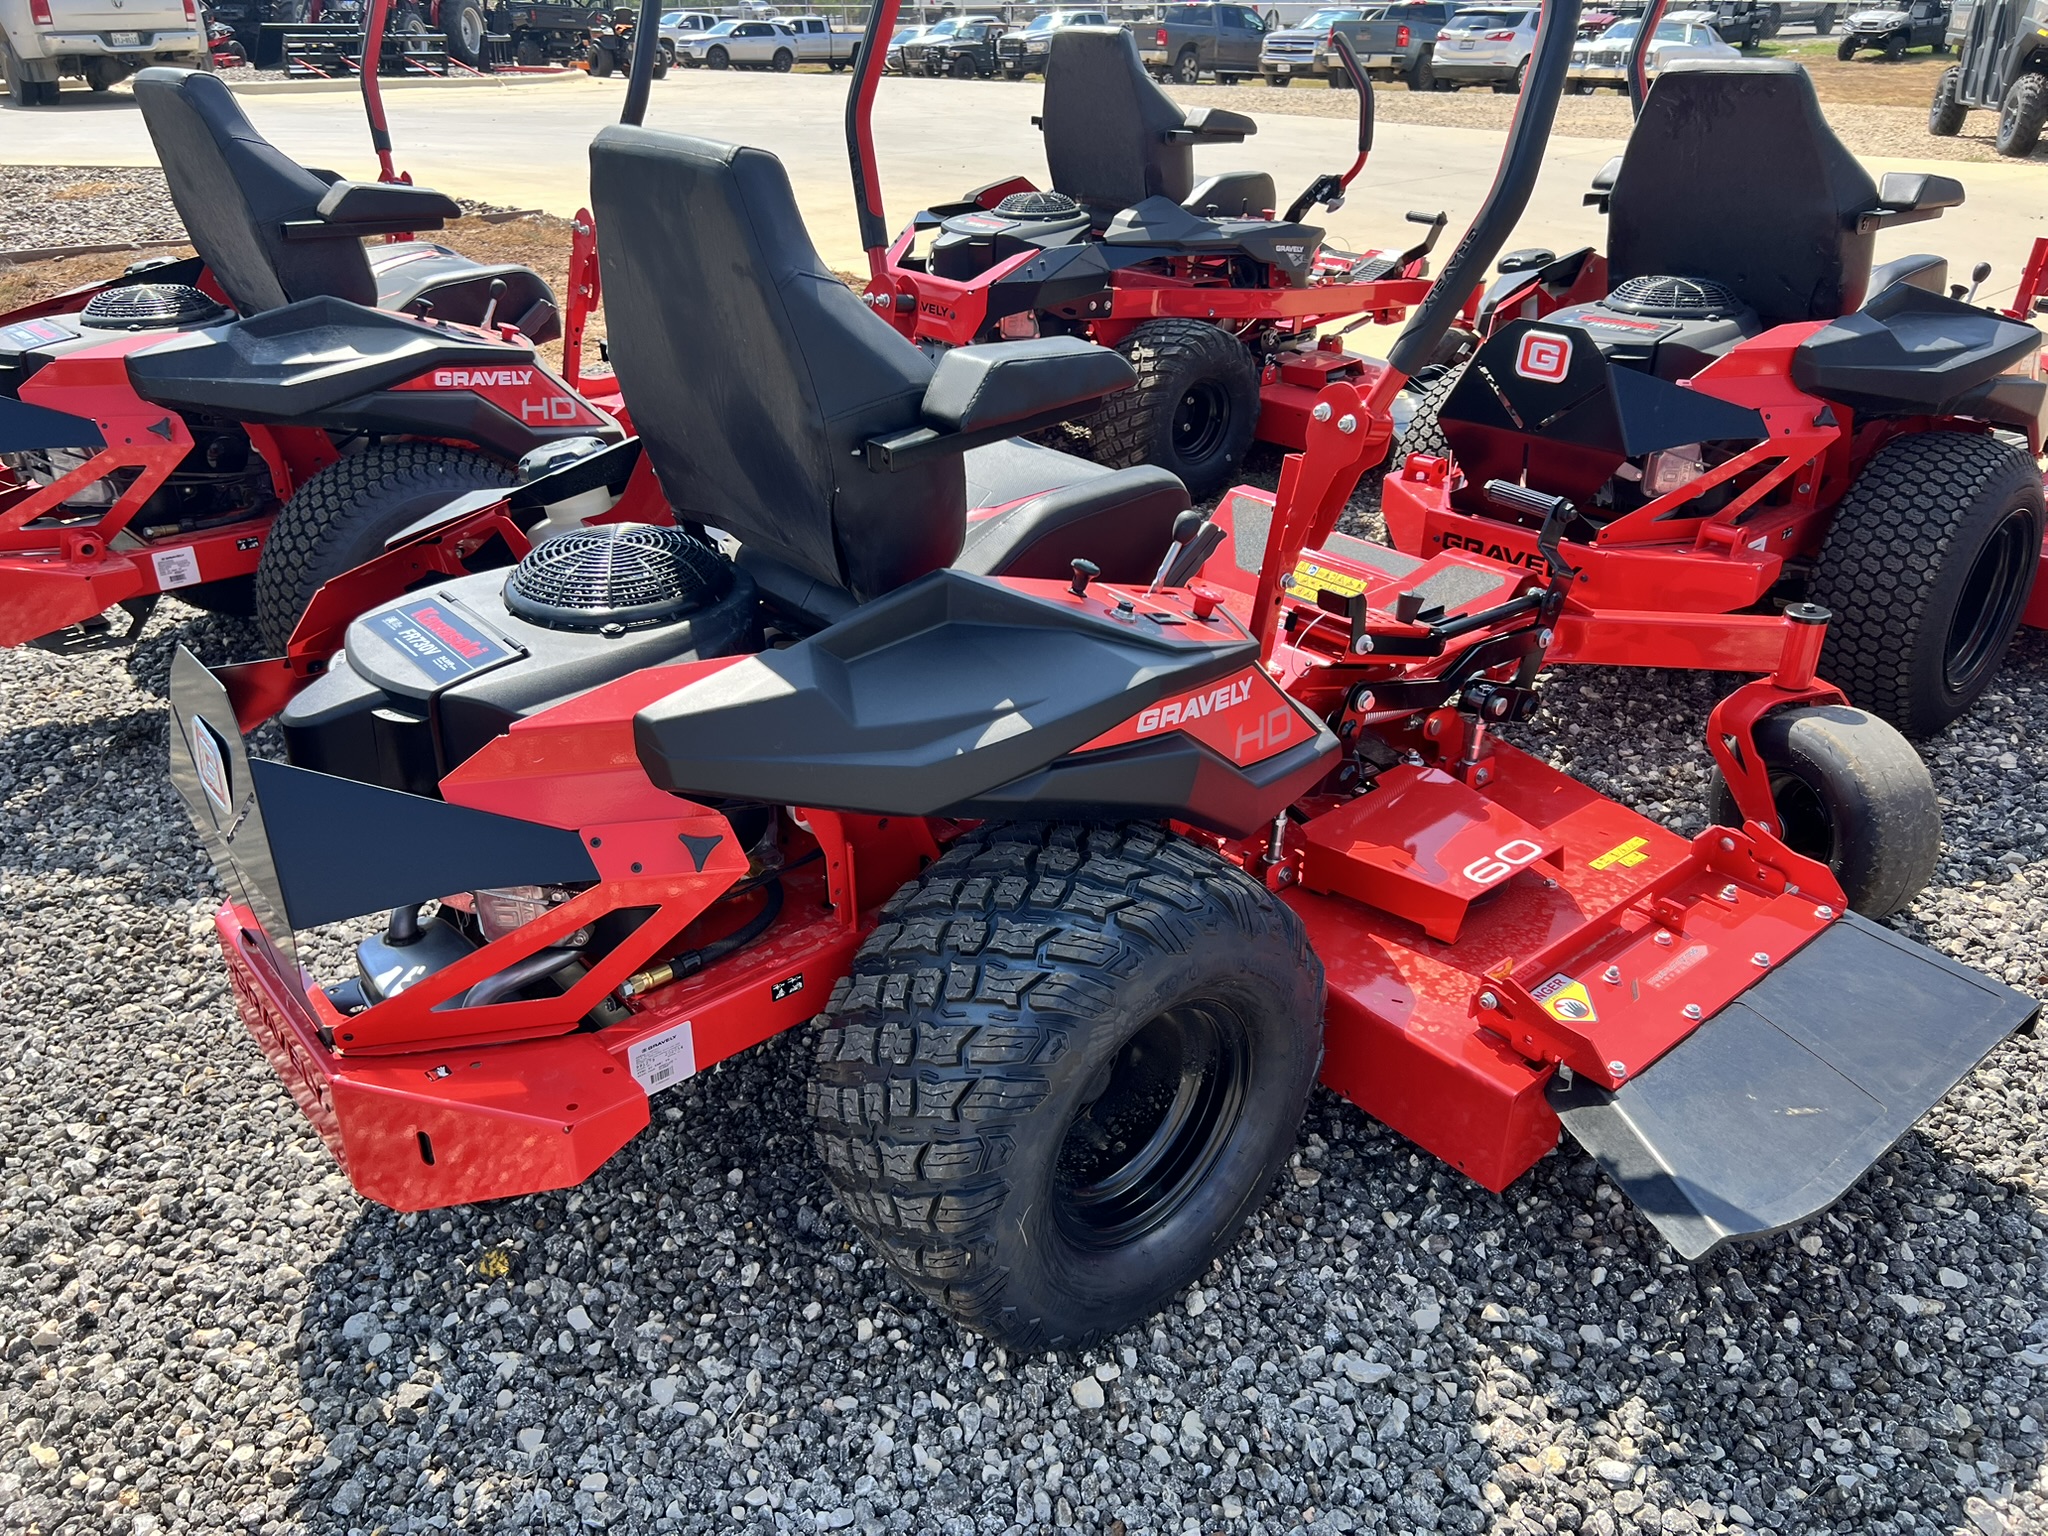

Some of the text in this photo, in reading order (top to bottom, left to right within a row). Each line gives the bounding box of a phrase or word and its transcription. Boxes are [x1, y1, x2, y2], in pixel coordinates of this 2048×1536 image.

[1275, 245, 1305, 253] GRAVELY
[1424, 228, 1479, 312] GRAVELY
[920, 301, 949, 317] VELY
[434, 370, 533, 386] GRAVELY
[521, 397, 577, 420] HD
[398, 628, 442, 656] FR730V
[410, 606, 490, 660] Kawasaki
[1136, 676, 1253, 734] GRAVELY
[1234, 704, 1292, 760] HD
[1463, 839, 1543, 884] 60
[1534, 978, 1567, 1002] NGER
[647, 1035, 677, 1051] GRAVELY
